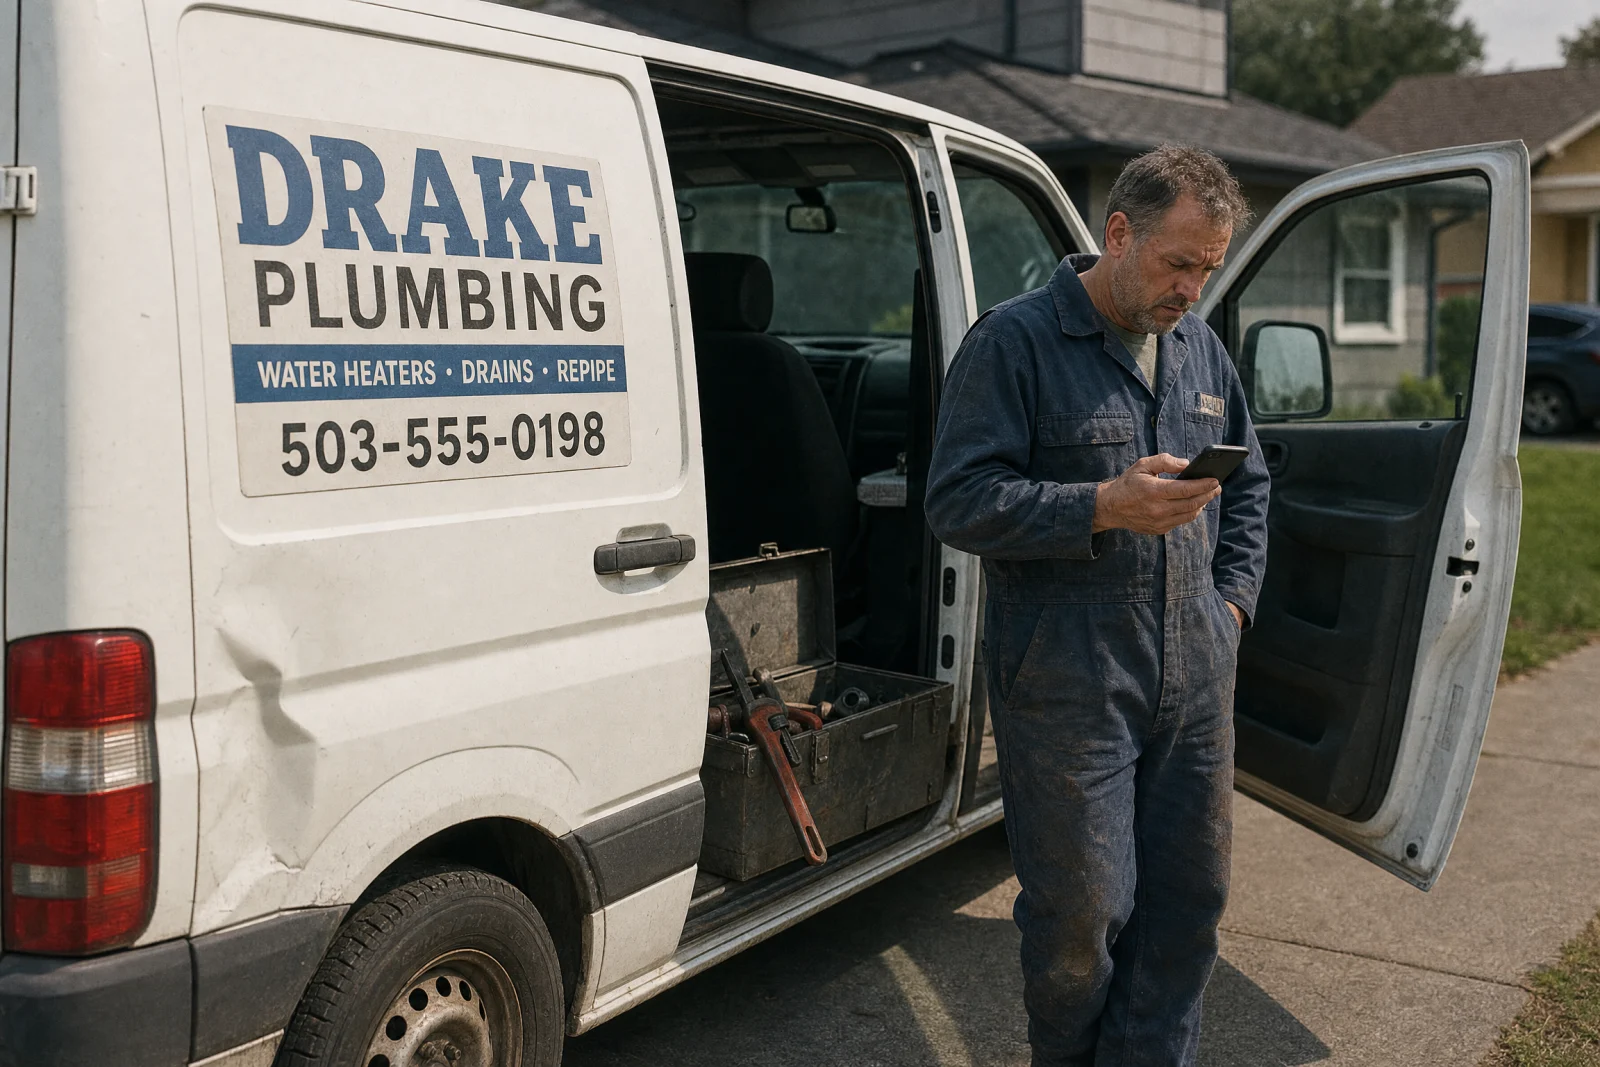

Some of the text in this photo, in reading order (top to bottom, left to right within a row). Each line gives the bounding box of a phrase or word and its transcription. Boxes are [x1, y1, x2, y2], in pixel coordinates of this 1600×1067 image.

[225, 124, 603, 265] DRAKE
[254, 259, 606, 332] PLUMBING
[257, 359, 616, 388] WATER HEATERS DRAINS REPIPE
[281, 411, 606, 477] 503-555-0198
